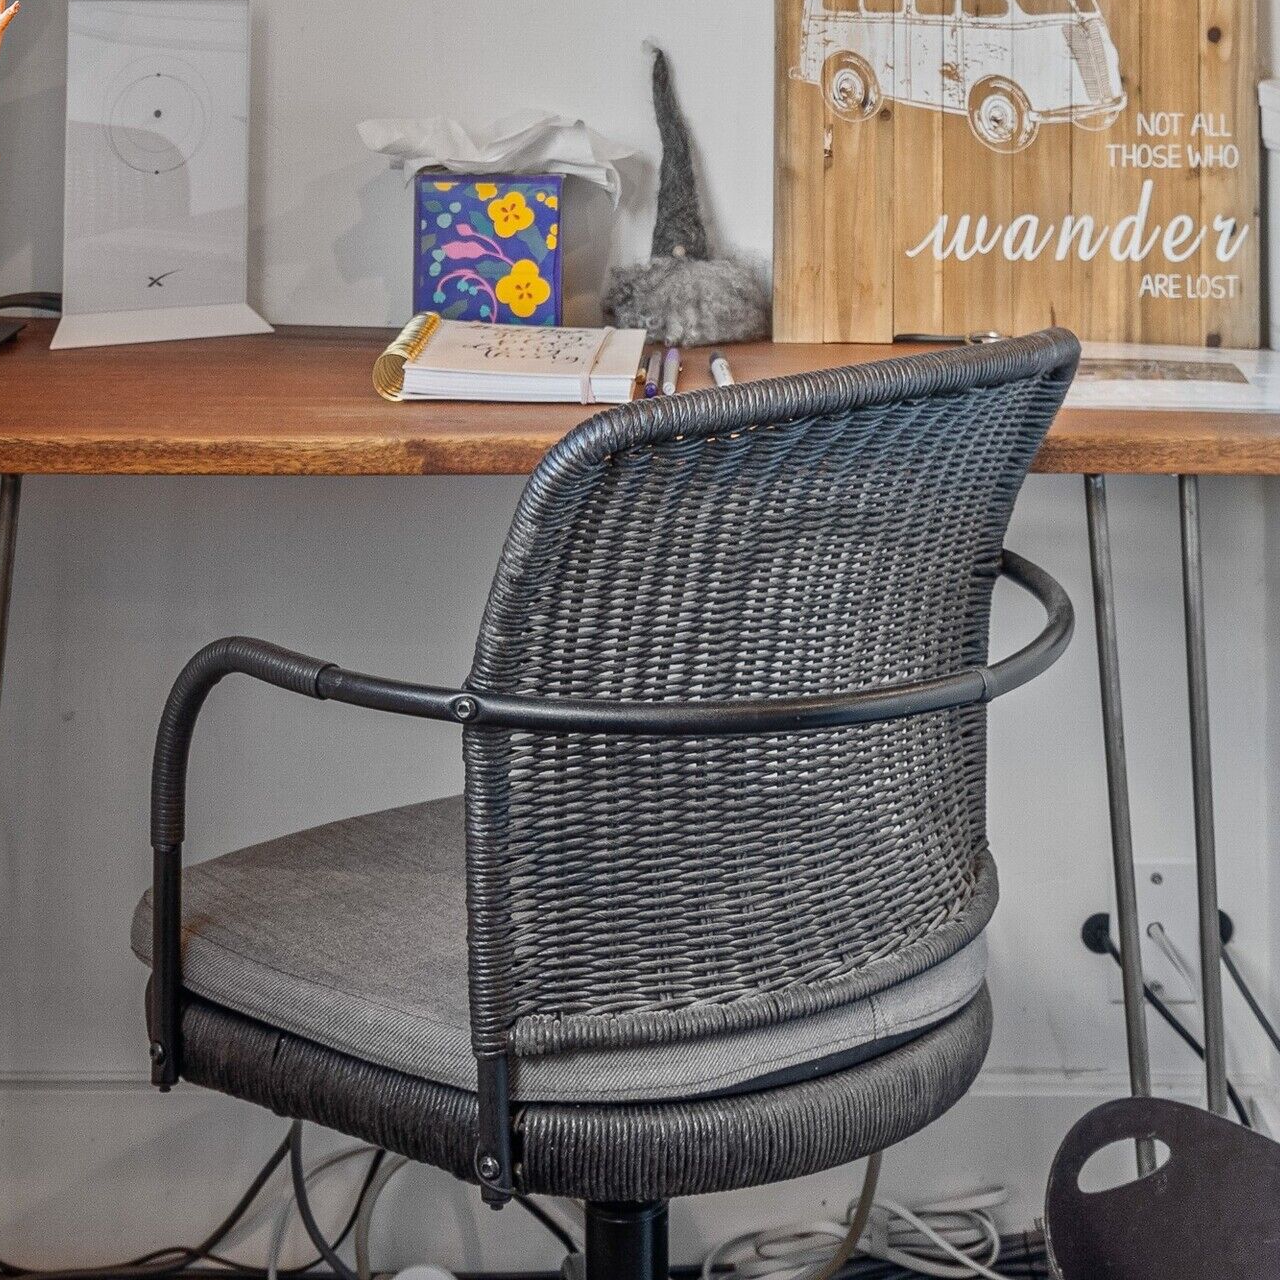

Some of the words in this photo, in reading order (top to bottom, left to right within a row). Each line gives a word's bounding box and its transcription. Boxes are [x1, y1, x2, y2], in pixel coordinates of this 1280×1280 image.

[1136, 113, 1185, 137] NOT
[1191, 113, 1232, 137] ALL
[1106, 144, 1182, 169] THOSE
[1187, 145, 1240, 168] WHO
[906, 179, 1250, 263] wander
[1138, 274, 1182, 299] ARE
[1187, 274, 1239, 299] LOST
